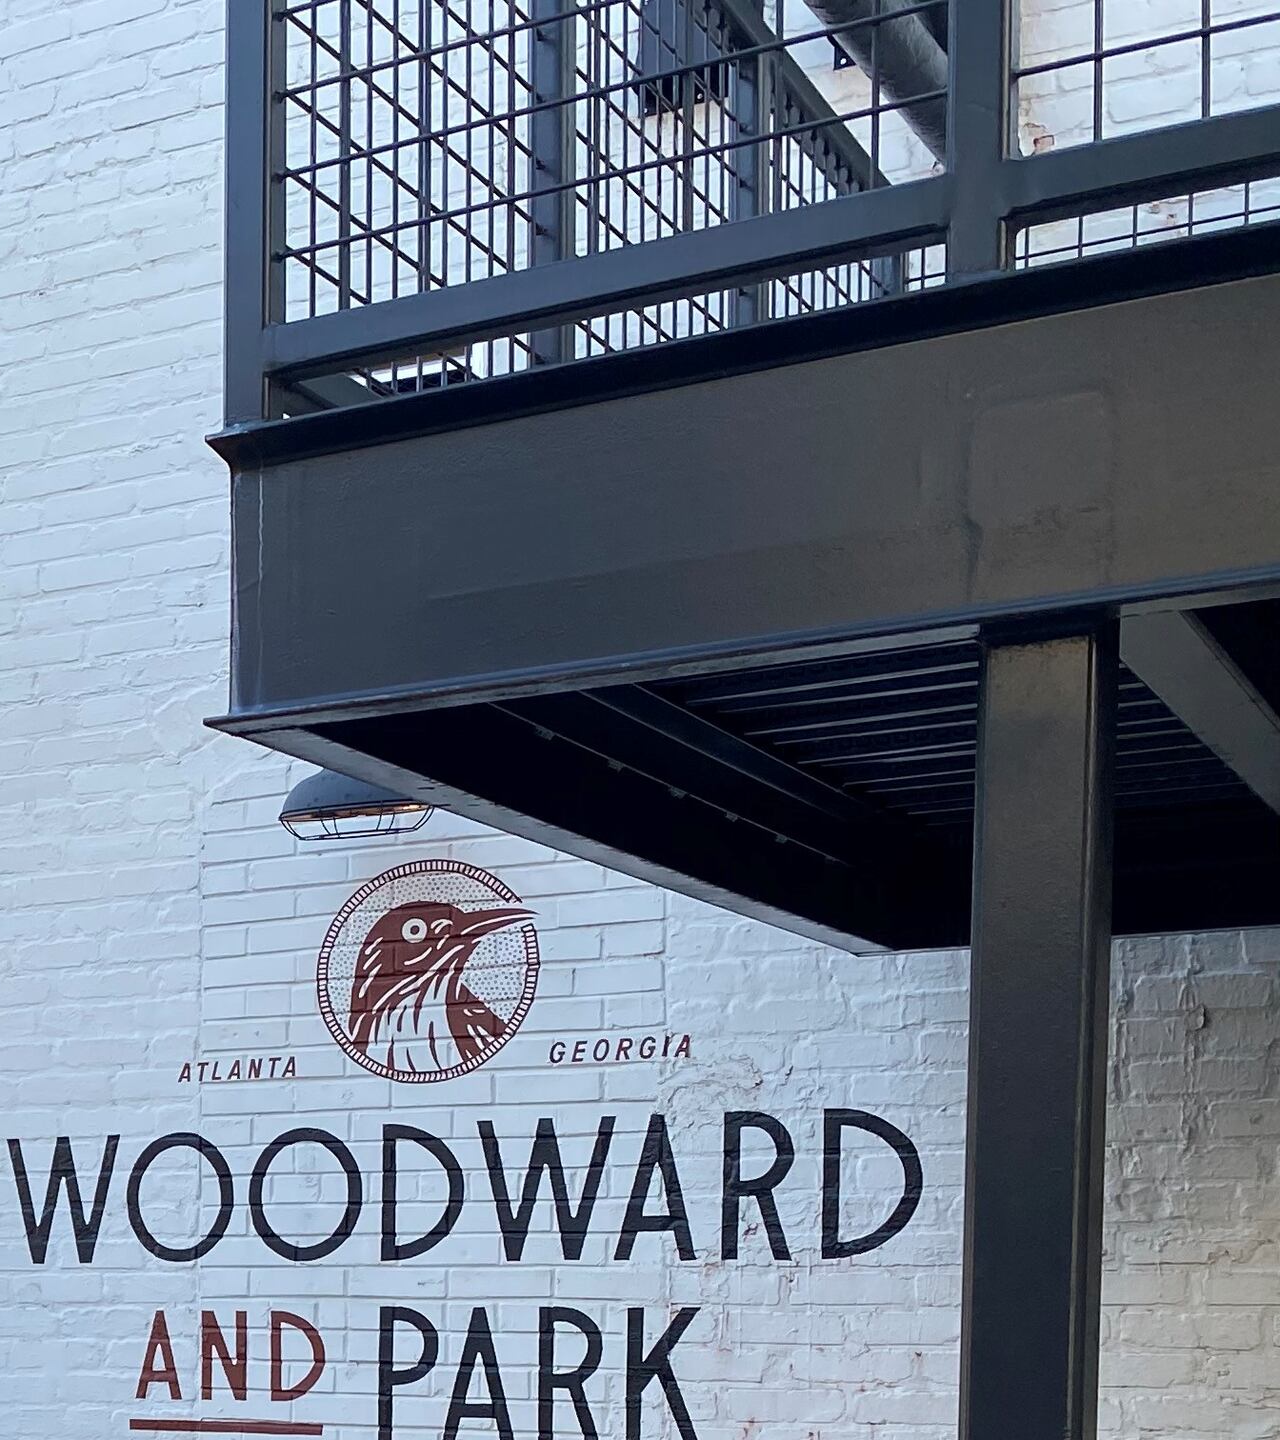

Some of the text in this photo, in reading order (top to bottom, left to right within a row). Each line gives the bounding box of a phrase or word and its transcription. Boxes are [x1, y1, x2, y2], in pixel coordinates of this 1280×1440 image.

[177, 1055, 298, 1084] ATLANTA
[548, 1033, 693, 1064] GEORGIA
[6, 1107, 924, 1265] WOODWARD
[135, 1310, 327, 1402] AND
